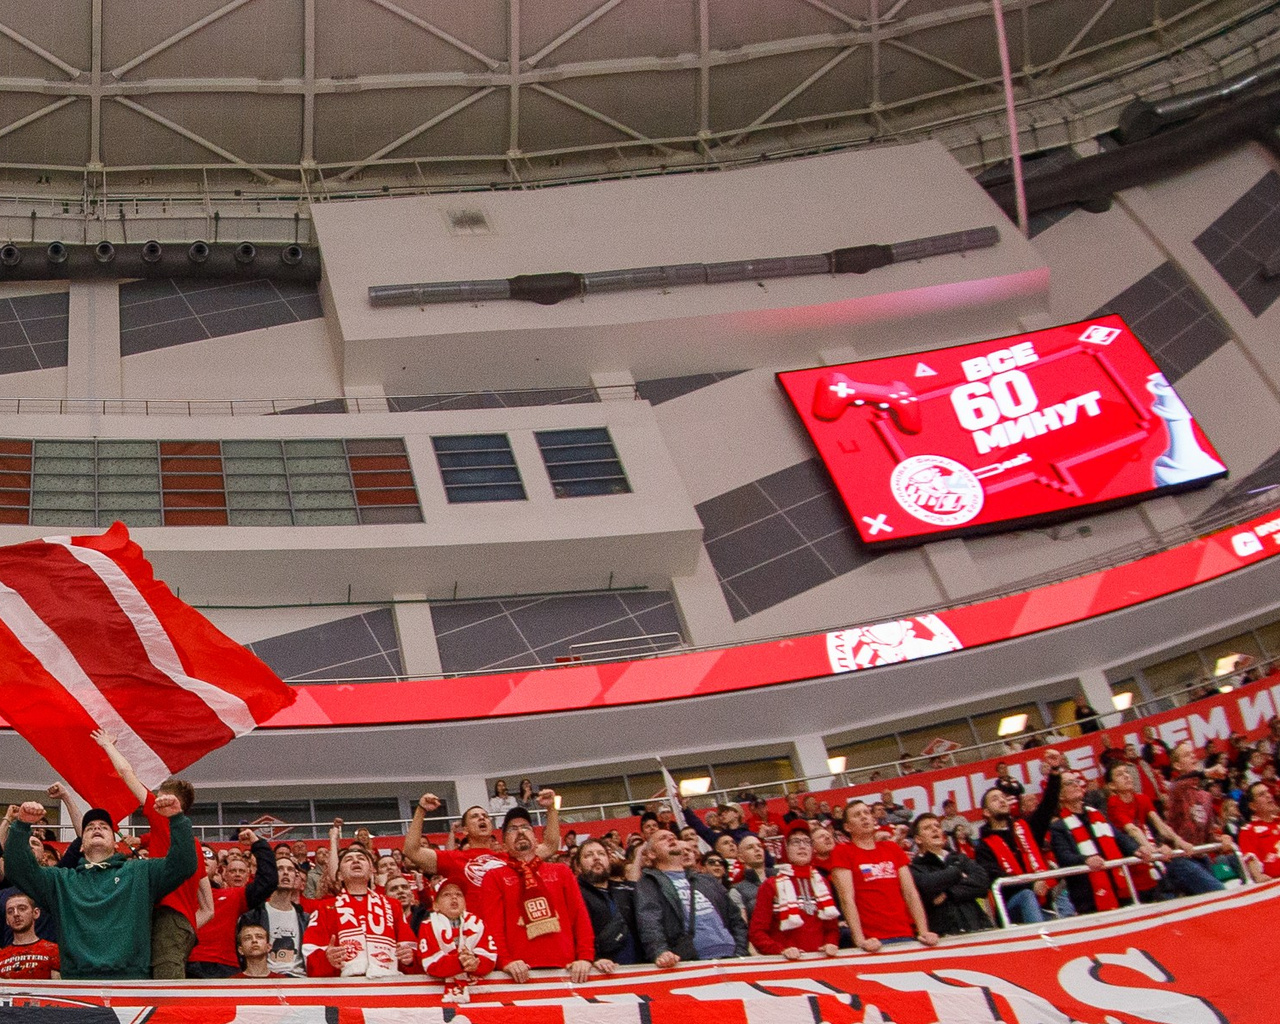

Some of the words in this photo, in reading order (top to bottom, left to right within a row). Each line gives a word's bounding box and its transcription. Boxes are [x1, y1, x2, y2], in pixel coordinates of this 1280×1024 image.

[961, 341, 1039, 381] ВСЕ
[950, 370, 1038, 431] 60
[972, 391, 1101, 455] МИНУТ
[527, 899, 547, 913] 80
